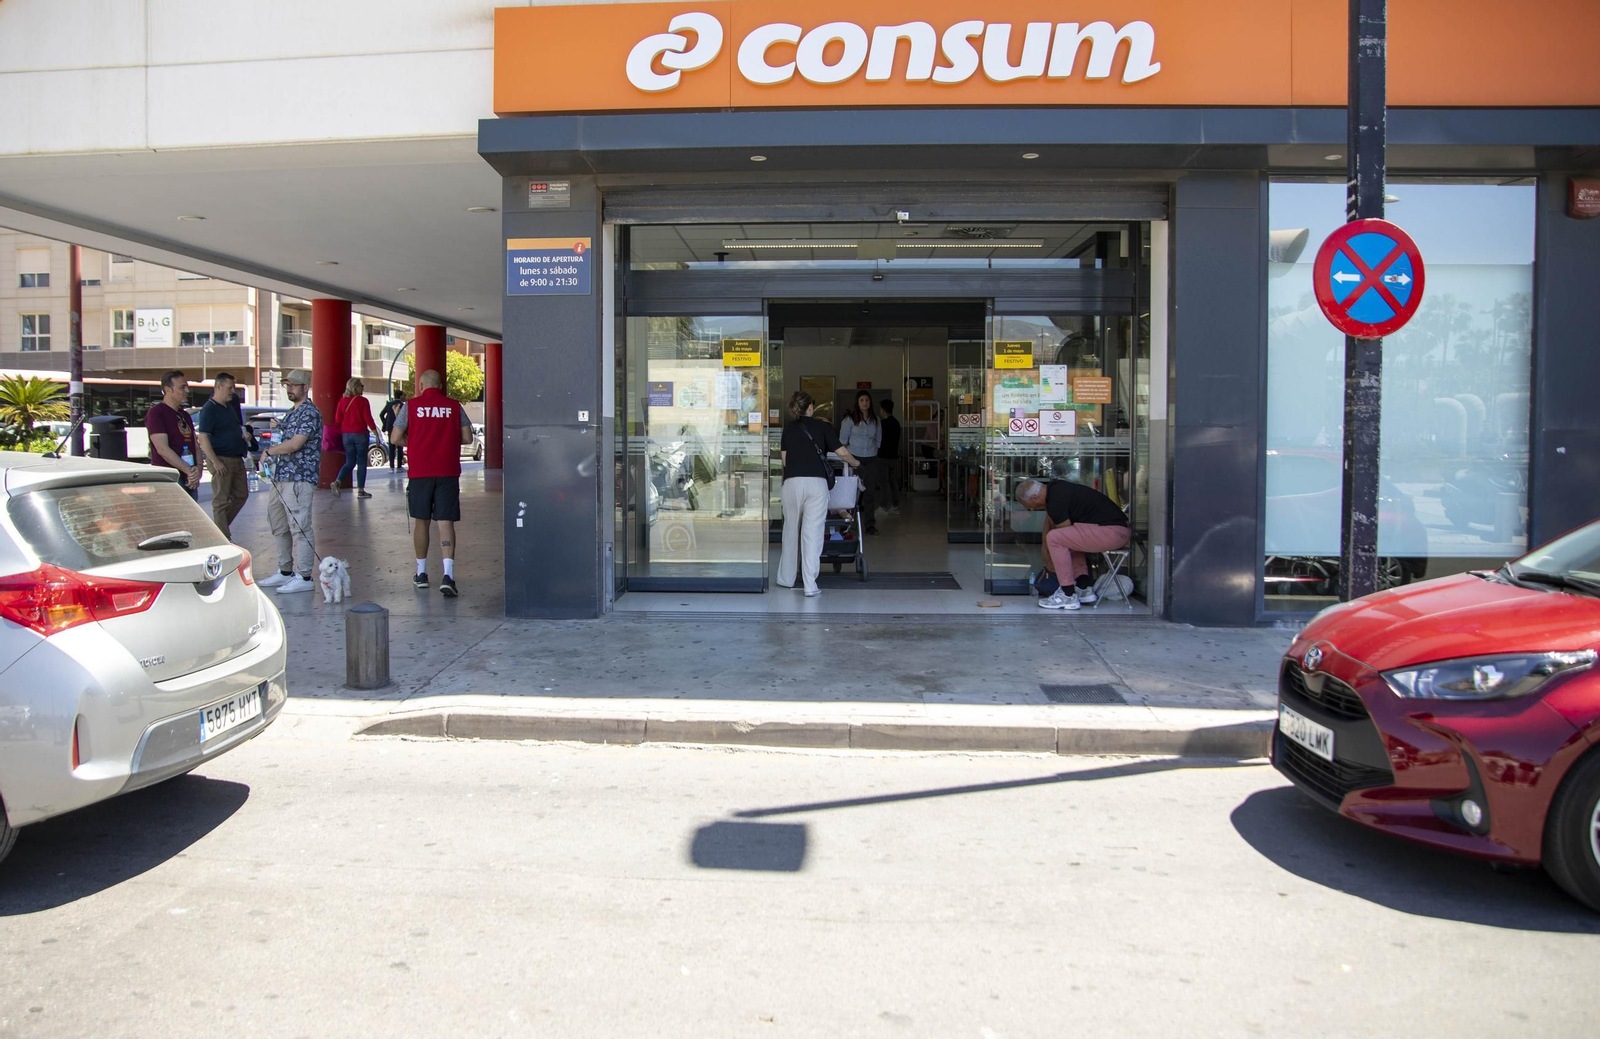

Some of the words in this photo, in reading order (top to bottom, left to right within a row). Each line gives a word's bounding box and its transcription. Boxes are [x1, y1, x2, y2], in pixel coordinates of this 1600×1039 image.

[737, 20, 1161, 85] consum
[513, 256, 542, 264] HORARIO
[551, 255, 584, 263] APERTURA
[519, 266, 541, 275] lunes
[549, 265, 578, 275] sábado
[519, 278, 529, 287] de
[530, 278, 548, 286] 9:00
[555, 277, 578, 286] 21:30
[416, 406, 452, 418] STAFF
[206, 700, 236, 733] 5875
[238, 690, 257, 719] HYT
